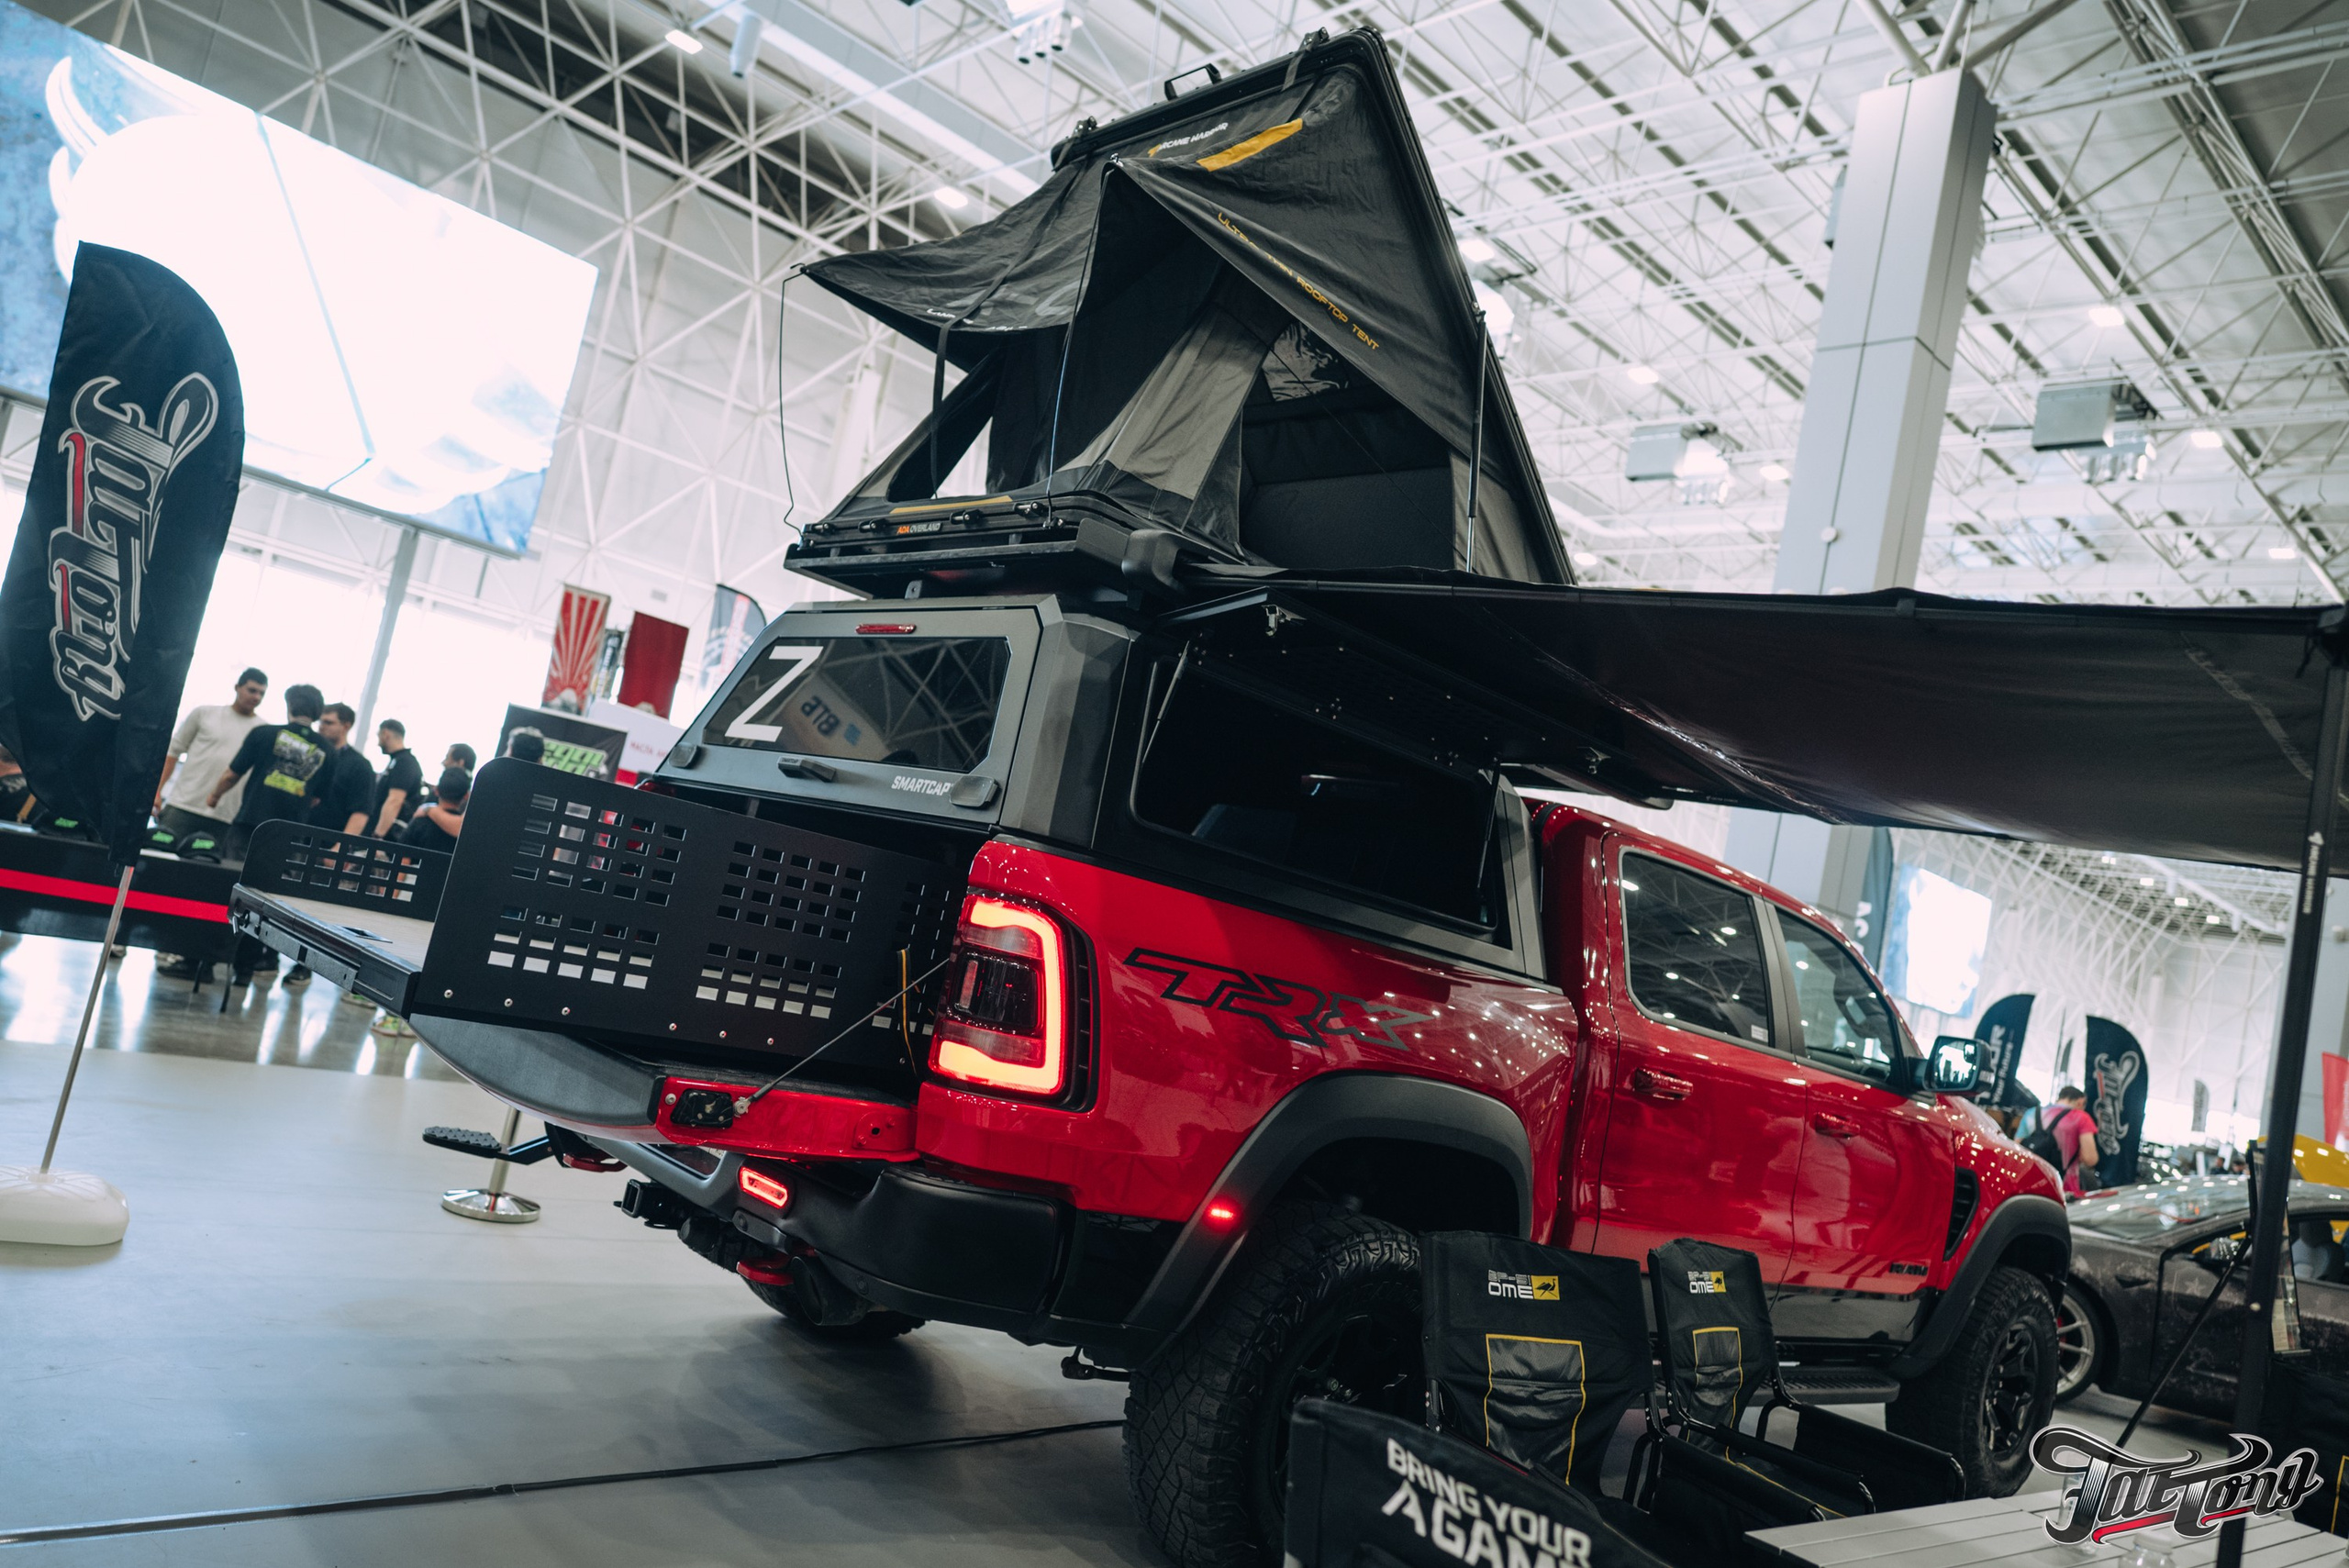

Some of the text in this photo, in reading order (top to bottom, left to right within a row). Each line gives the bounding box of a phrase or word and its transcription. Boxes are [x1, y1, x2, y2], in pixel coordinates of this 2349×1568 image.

[1297, 275, 1349, 323] ROOFTOP
[1353, 324, 1379, 350] TENT
[910, 522, 941, 533] OVERLAND
[724, 645, 824, 742] Z
[891, 775, 951, 796] SMARTCAP
[1488, 1282, 1534, 1299] OME
[1689, 1281, 1714, 1294] OME
[1381, 1479, 1592, 1568] A GAM
[1386, 1437, 1592, 1567] BRING YOUR
